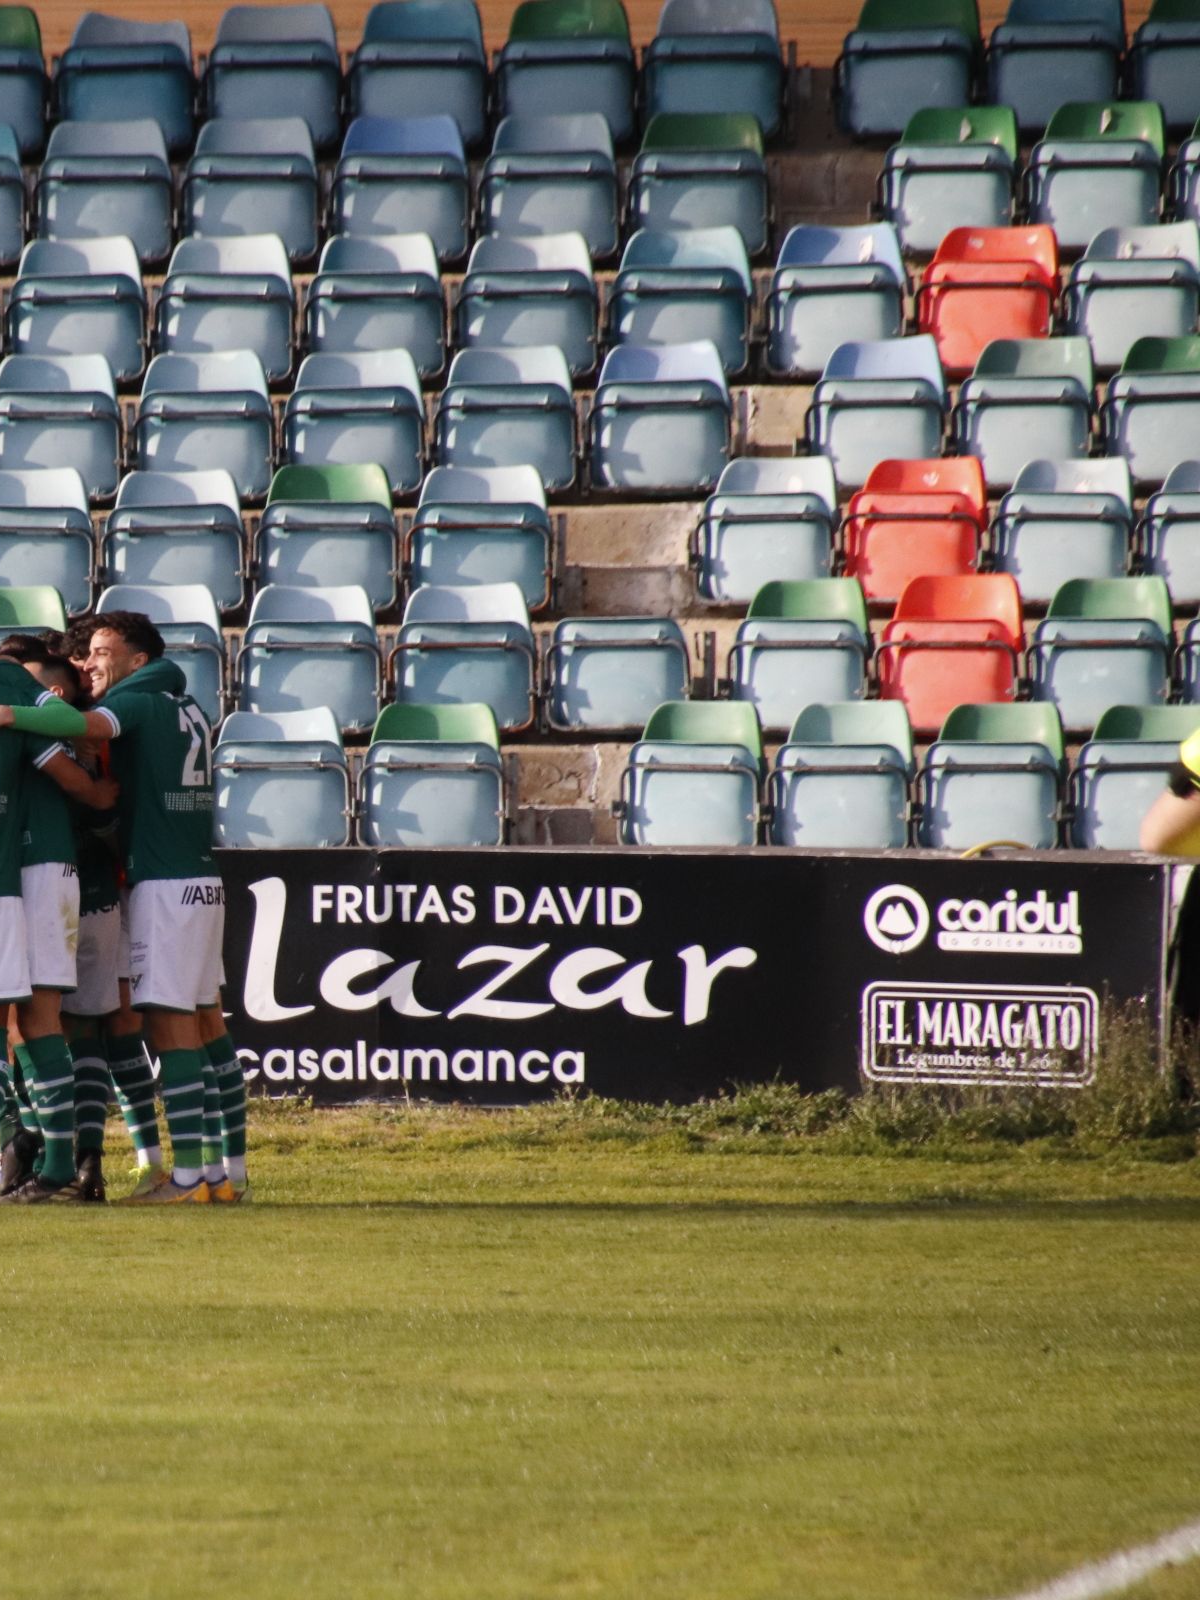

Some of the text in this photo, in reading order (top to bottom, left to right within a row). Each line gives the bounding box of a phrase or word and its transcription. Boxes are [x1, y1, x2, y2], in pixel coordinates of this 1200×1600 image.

[312, 884, 643, 926] FRUTAS DAVID
[937, 889, 1083, 935] caridul
[243, 876, 758, 1026] lazar
[878, 1000, 1081, 1050] EL MARAGATO
[896, 1048, 991, 1070] Legumbres
[994, 1050, 1017, 1069] de
